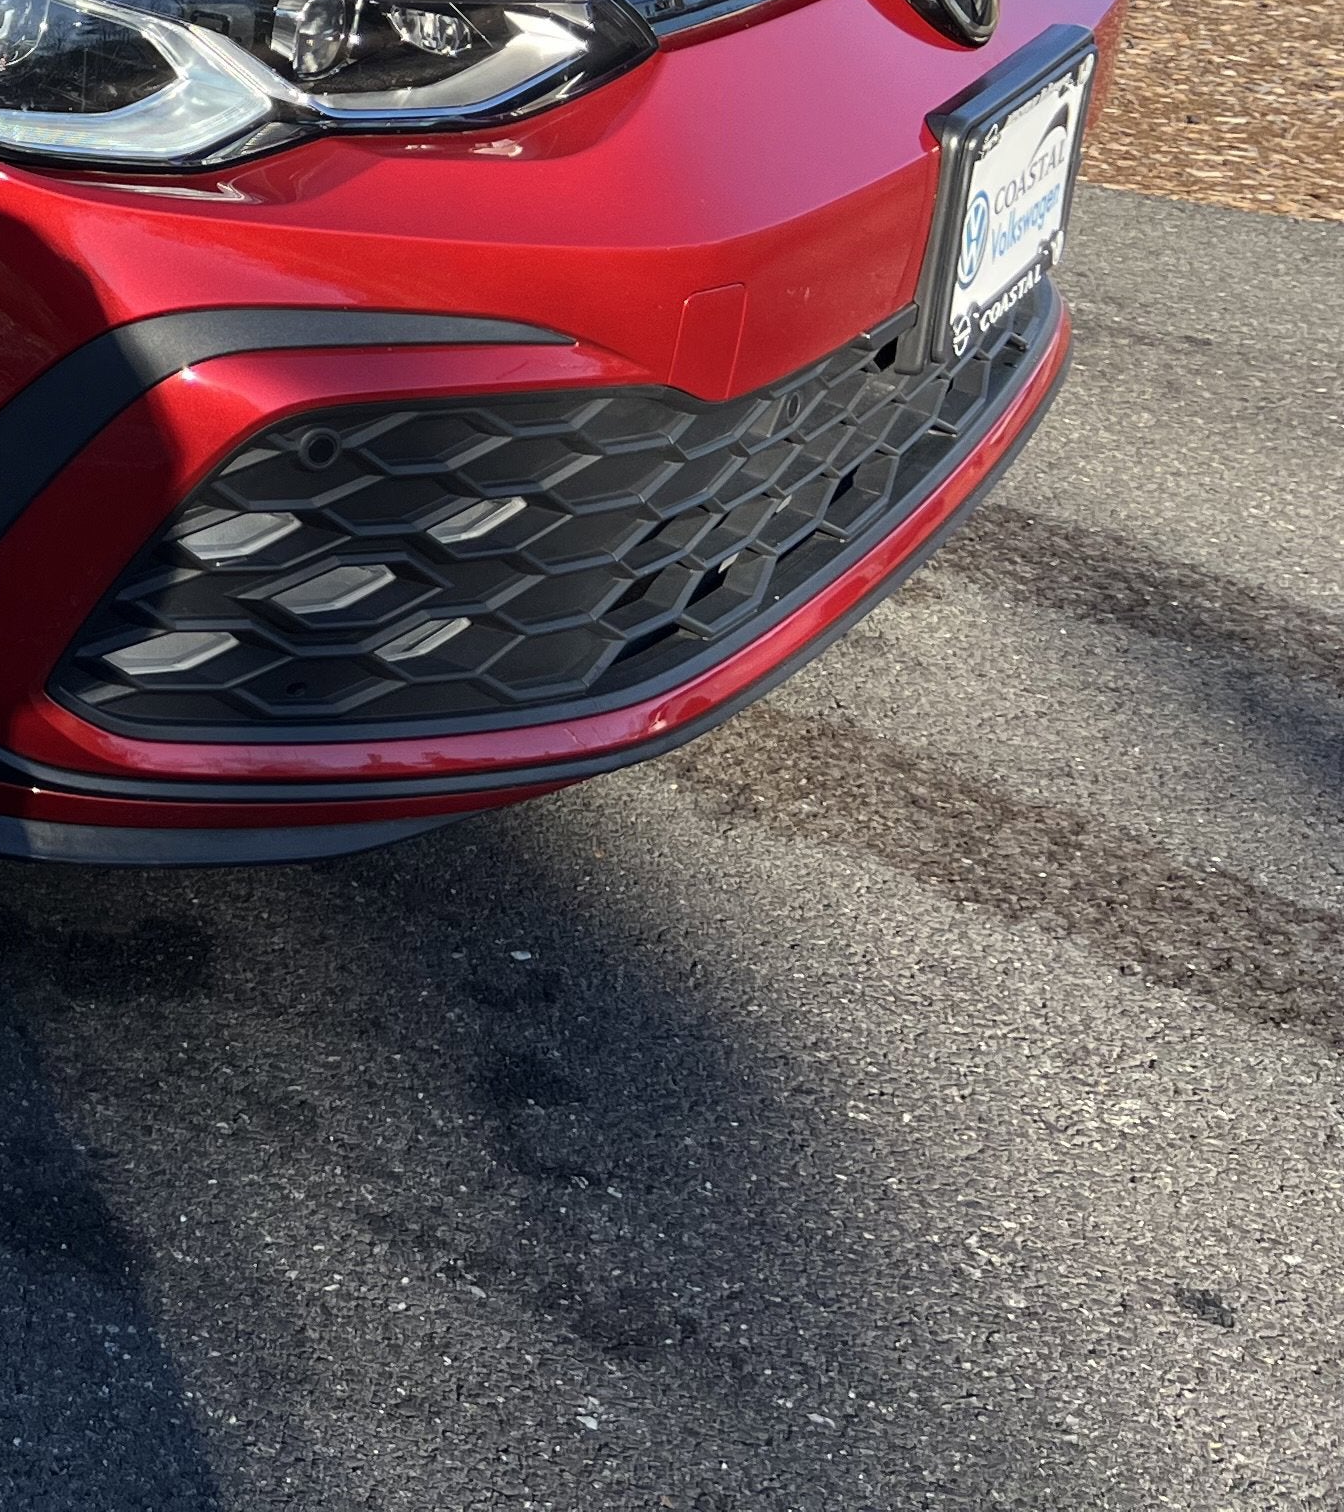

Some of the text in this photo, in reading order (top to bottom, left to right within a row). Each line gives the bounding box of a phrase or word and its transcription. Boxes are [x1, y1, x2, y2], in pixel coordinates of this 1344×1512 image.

[993, 144, 1067, 215] COASTAL
[957, 189, 990, 291] VW
[991, 182, 1062, 265] Volkswagen
[979, 263, 1043, 332] COASTAL
